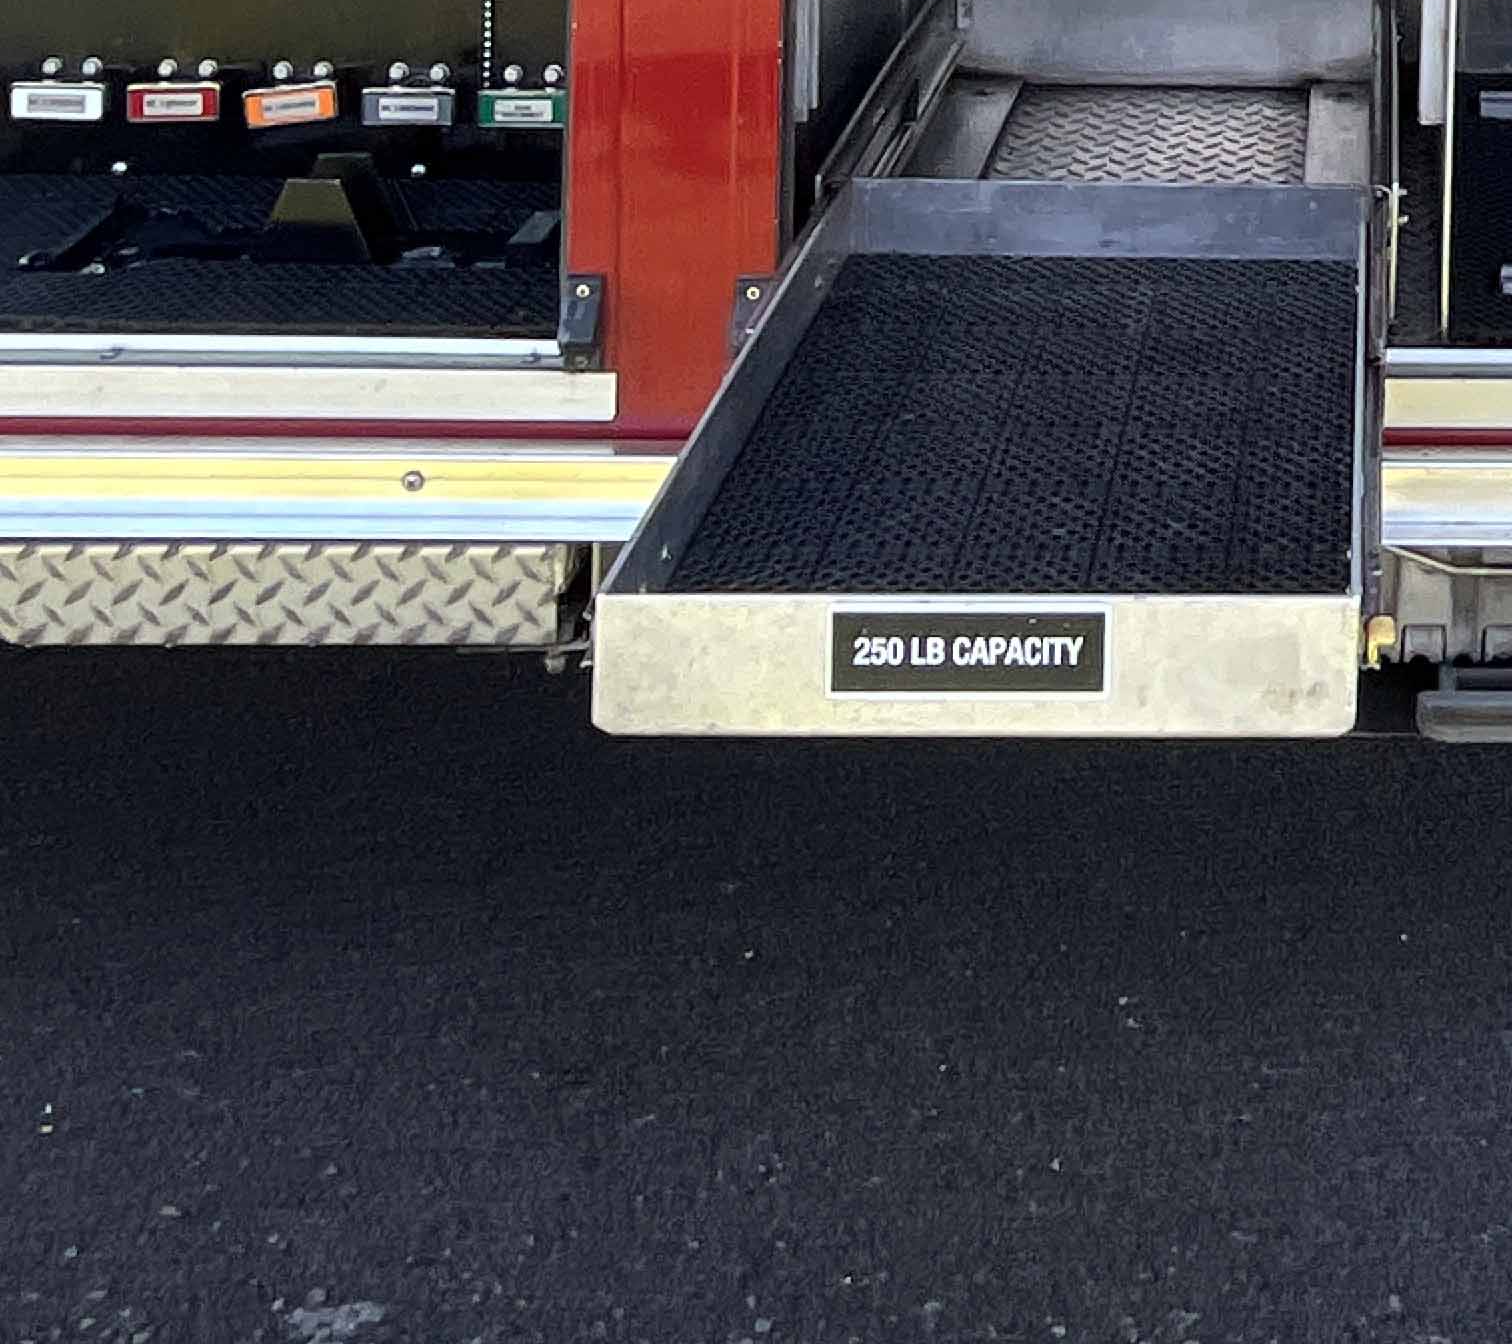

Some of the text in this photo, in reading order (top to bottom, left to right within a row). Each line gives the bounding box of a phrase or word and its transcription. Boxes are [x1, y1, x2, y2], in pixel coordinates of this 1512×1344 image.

[852, 635, 1085, 667] 250 LB CAPACITY
